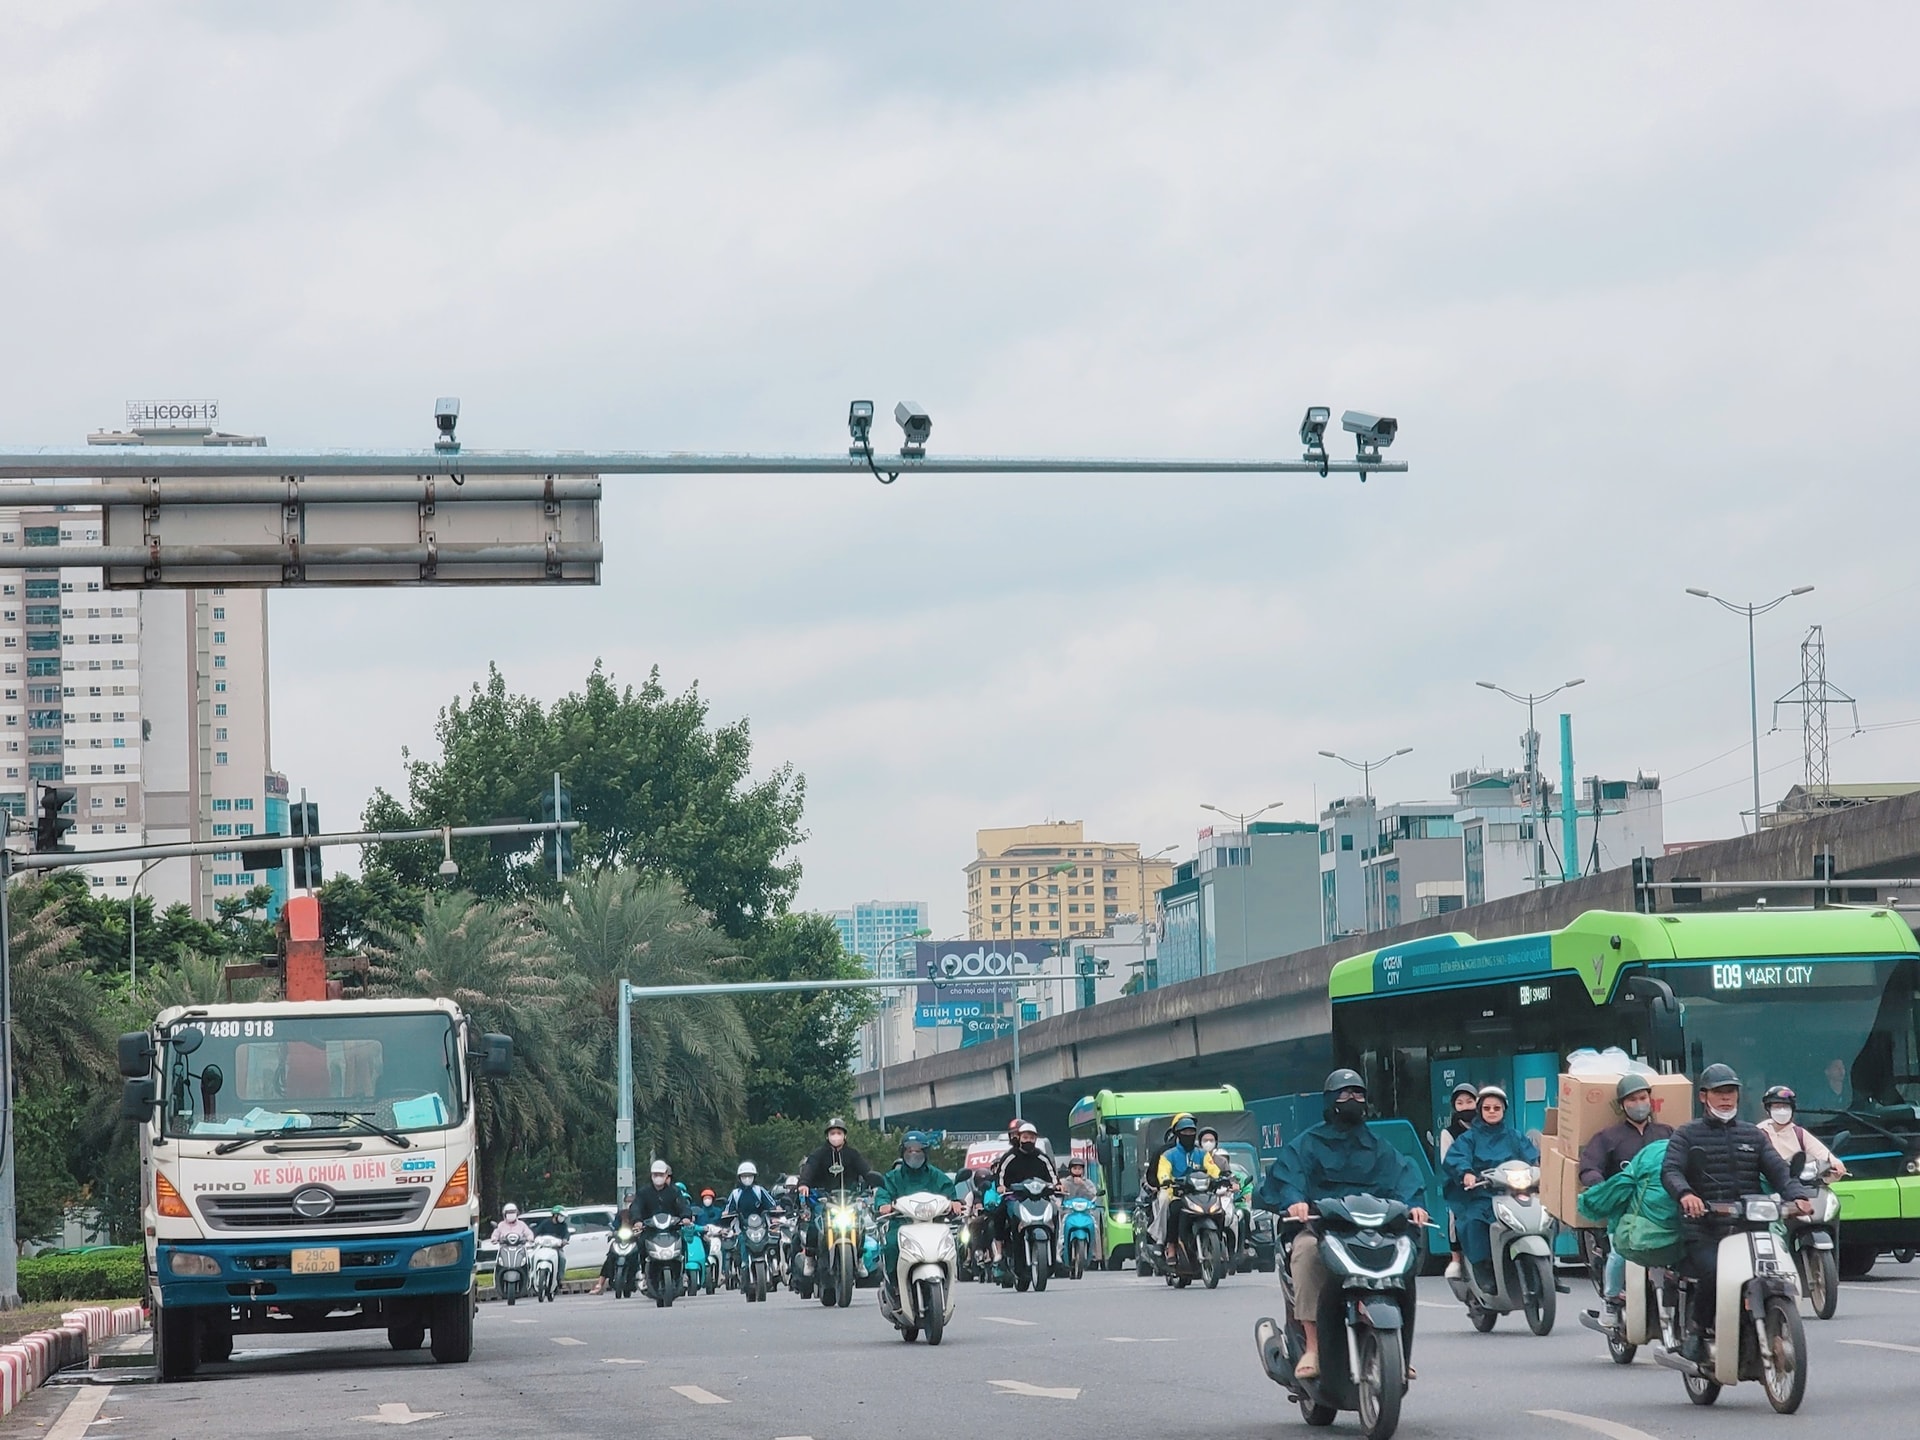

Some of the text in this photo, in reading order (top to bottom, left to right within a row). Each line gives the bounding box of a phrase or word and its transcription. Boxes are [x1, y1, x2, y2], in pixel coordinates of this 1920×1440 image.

[145, 404, 217, 420] LICOGI 13
[1382, 955, 1403, 970] OCEAN
[1387, 971, 1400, 985] CITY
[1713, 964, 1742, 989] E09
[1786, 966, 1812, 984] CITY
[210, 1021, 240, 1037] 480
[244, 1021, 274, 1037] 918
[253, 1168, 271, 1185] XE
[275, 1161, 304, 1184] SỬA
[395, 1175, 433, 1184] 500
[193, 1182, 247, 1191] HINO
[305, 1250, 326, 1261] 29C
[296, 1261, 335, 1273] 540.20
